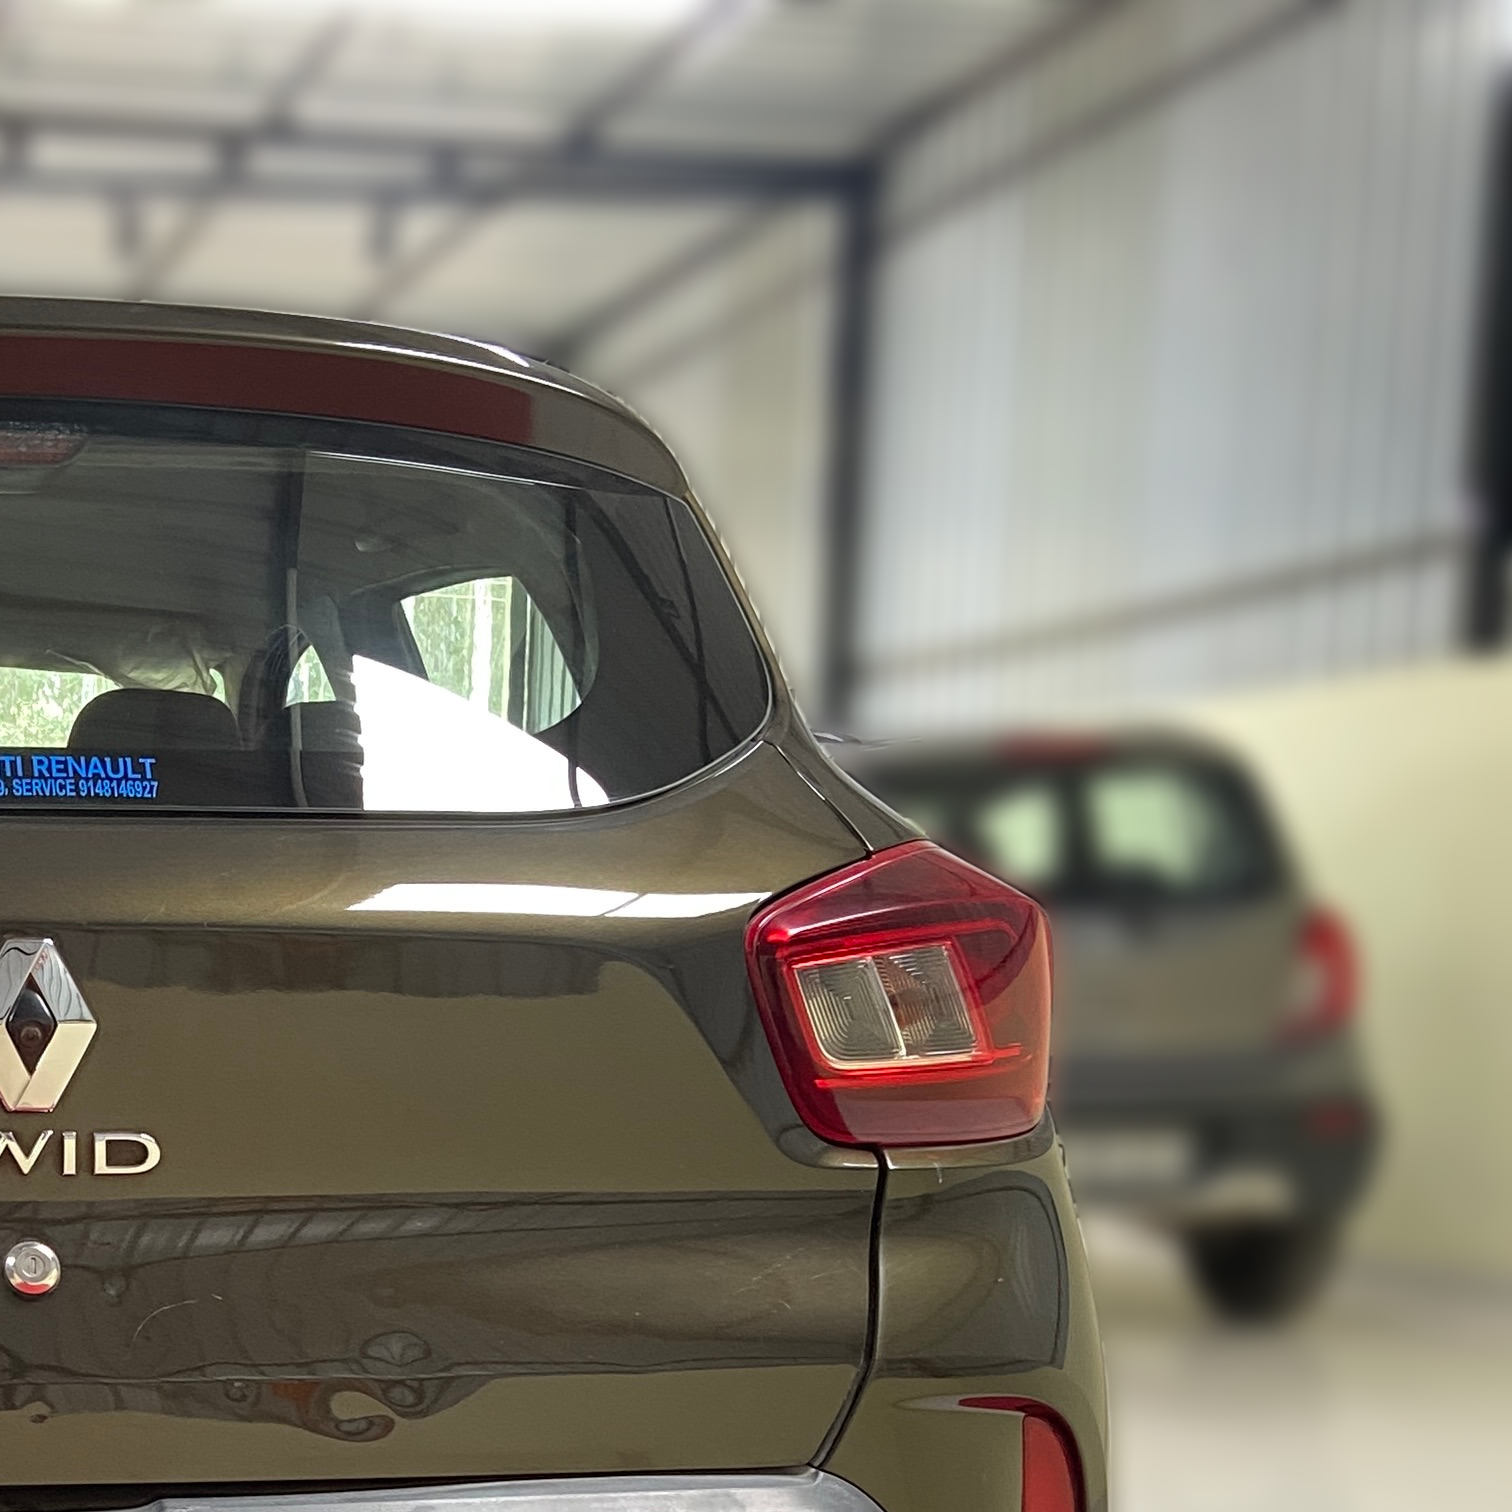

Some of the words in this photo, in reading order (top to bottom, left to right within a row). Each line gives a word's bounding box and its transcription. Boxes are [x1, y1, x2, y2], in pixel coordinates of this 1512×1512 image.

[31, 756, 156, 779] RENAULT
[12, 779, 76, 797] SERVICE
[79, 780, 159, 798] 9148146927
